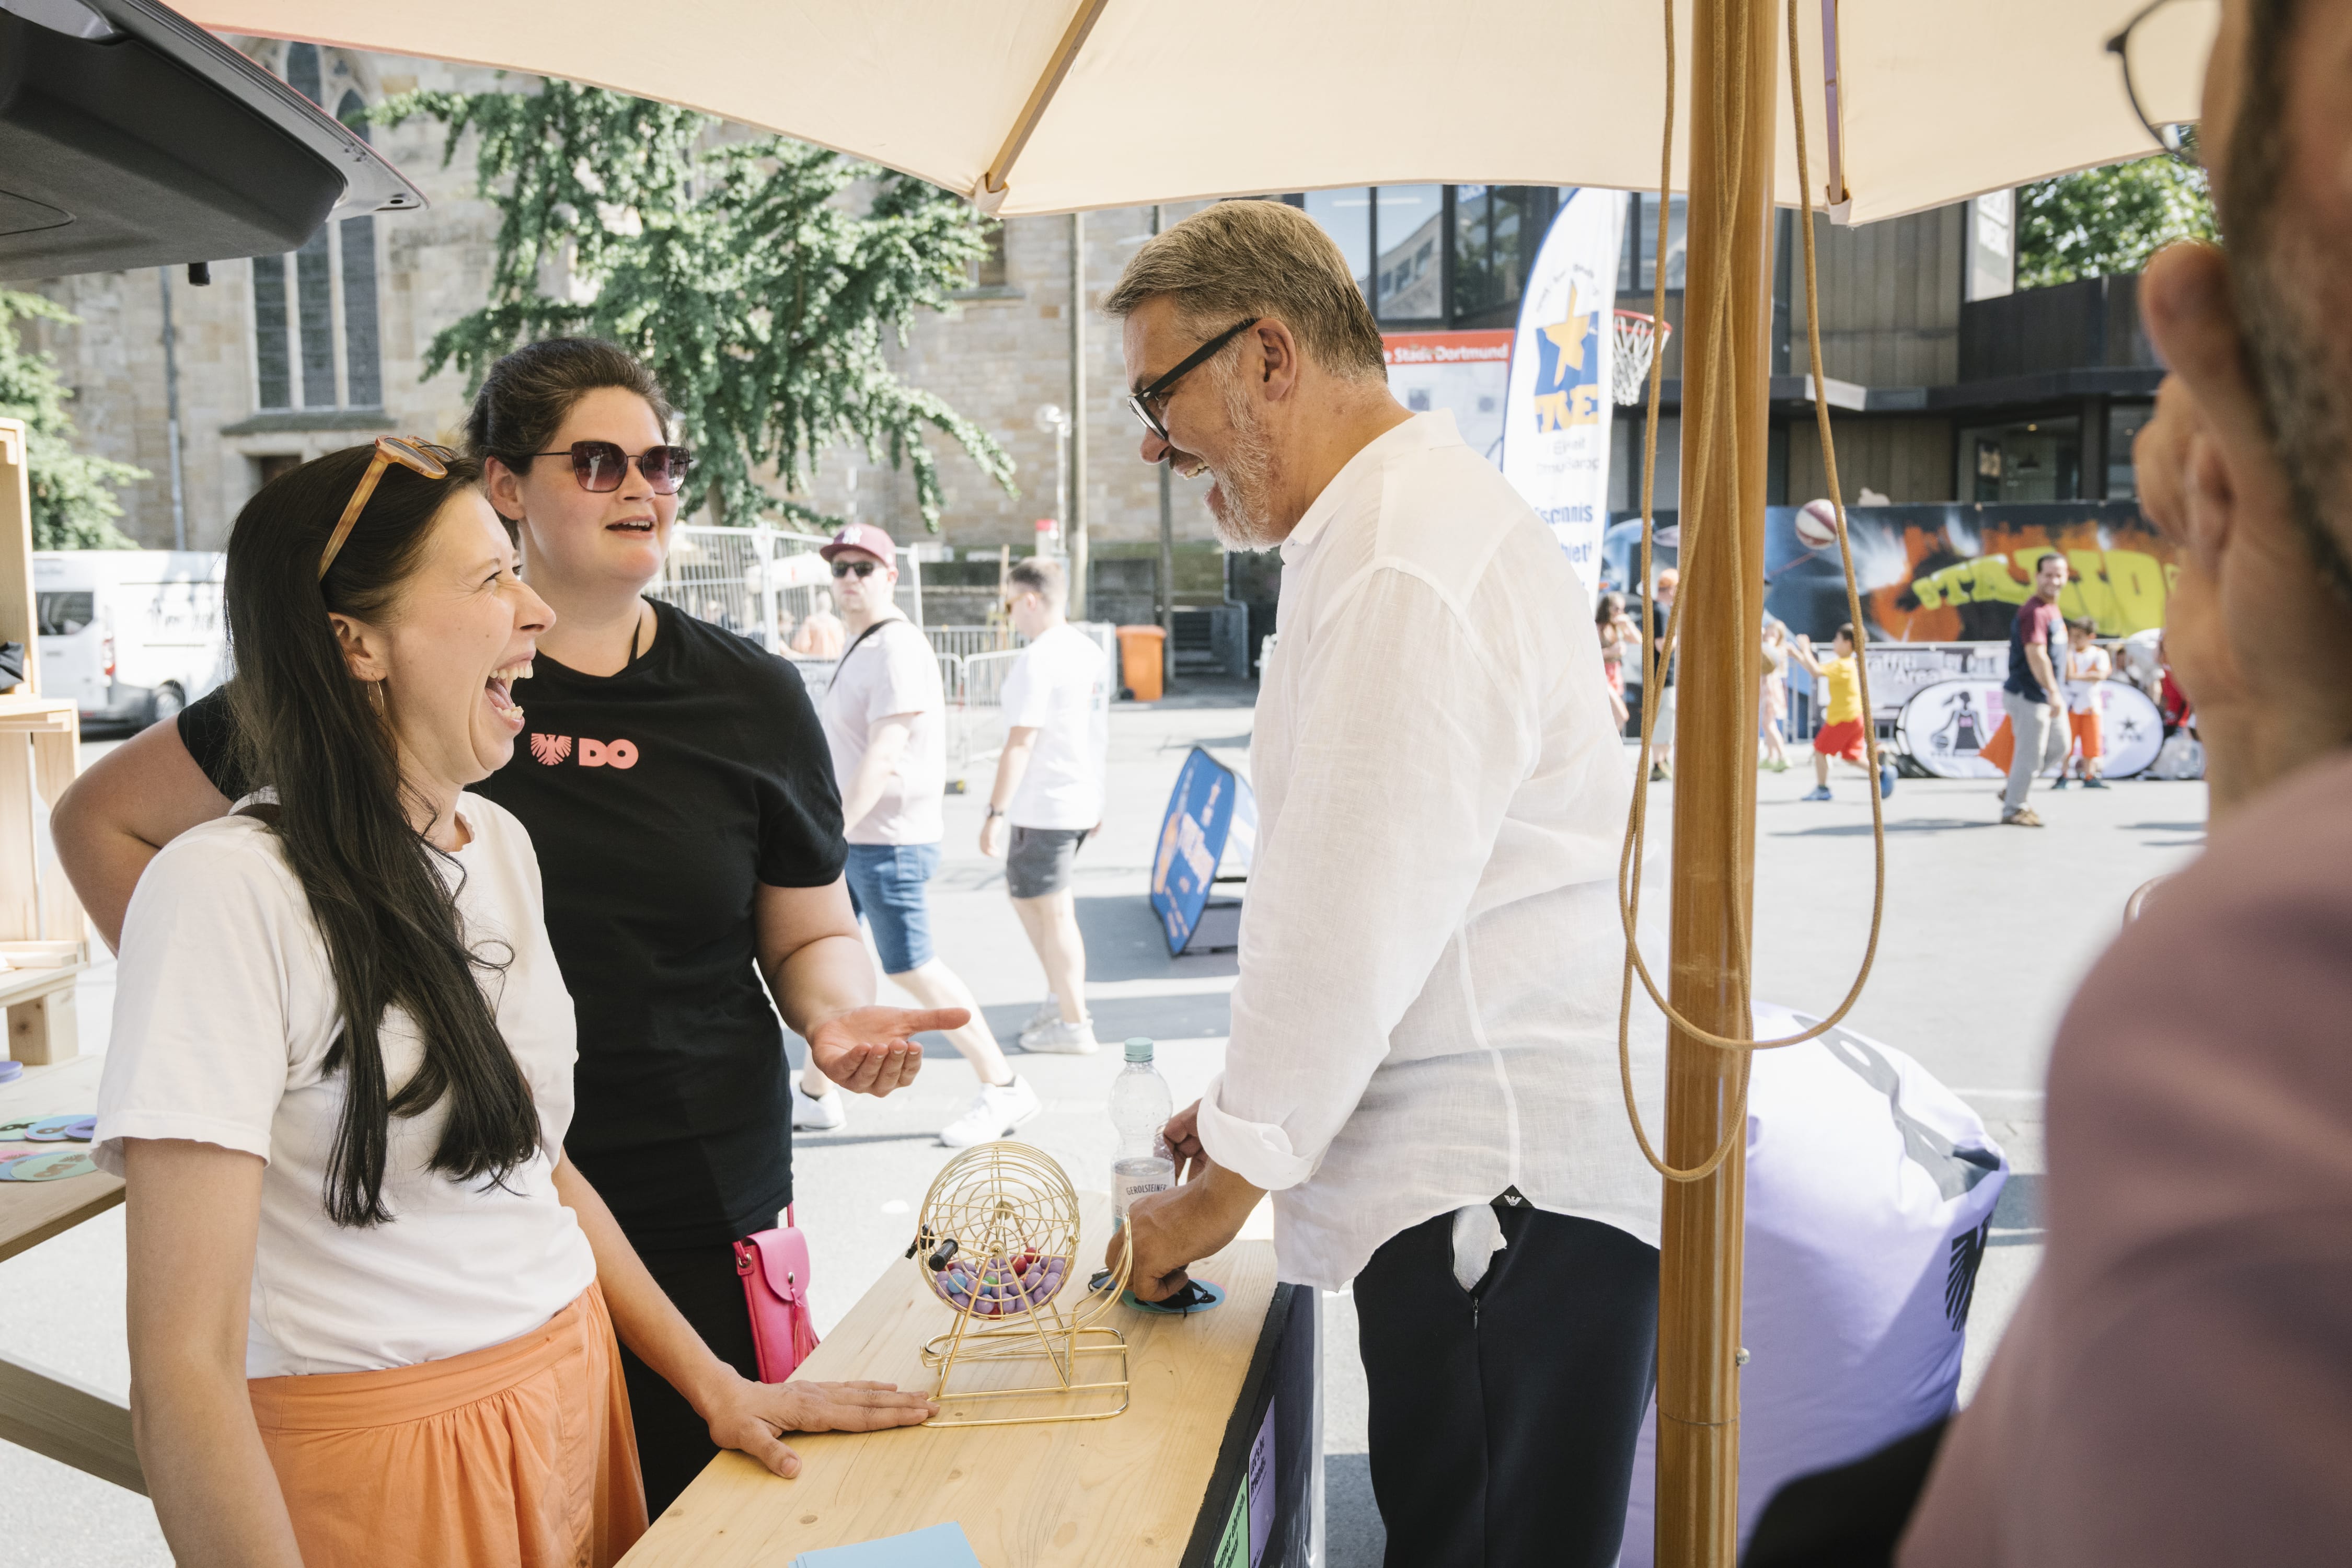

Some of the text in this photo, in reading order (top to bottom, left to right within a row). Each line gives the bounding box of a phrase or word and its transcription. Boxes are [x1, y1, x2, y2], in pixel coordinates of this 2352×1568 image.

[1435, 342, 1508, 361] Dortmund
[579, 737, 639, 769] DO
[1126, 1183, 1167, 1195] GEROLSTEINER
